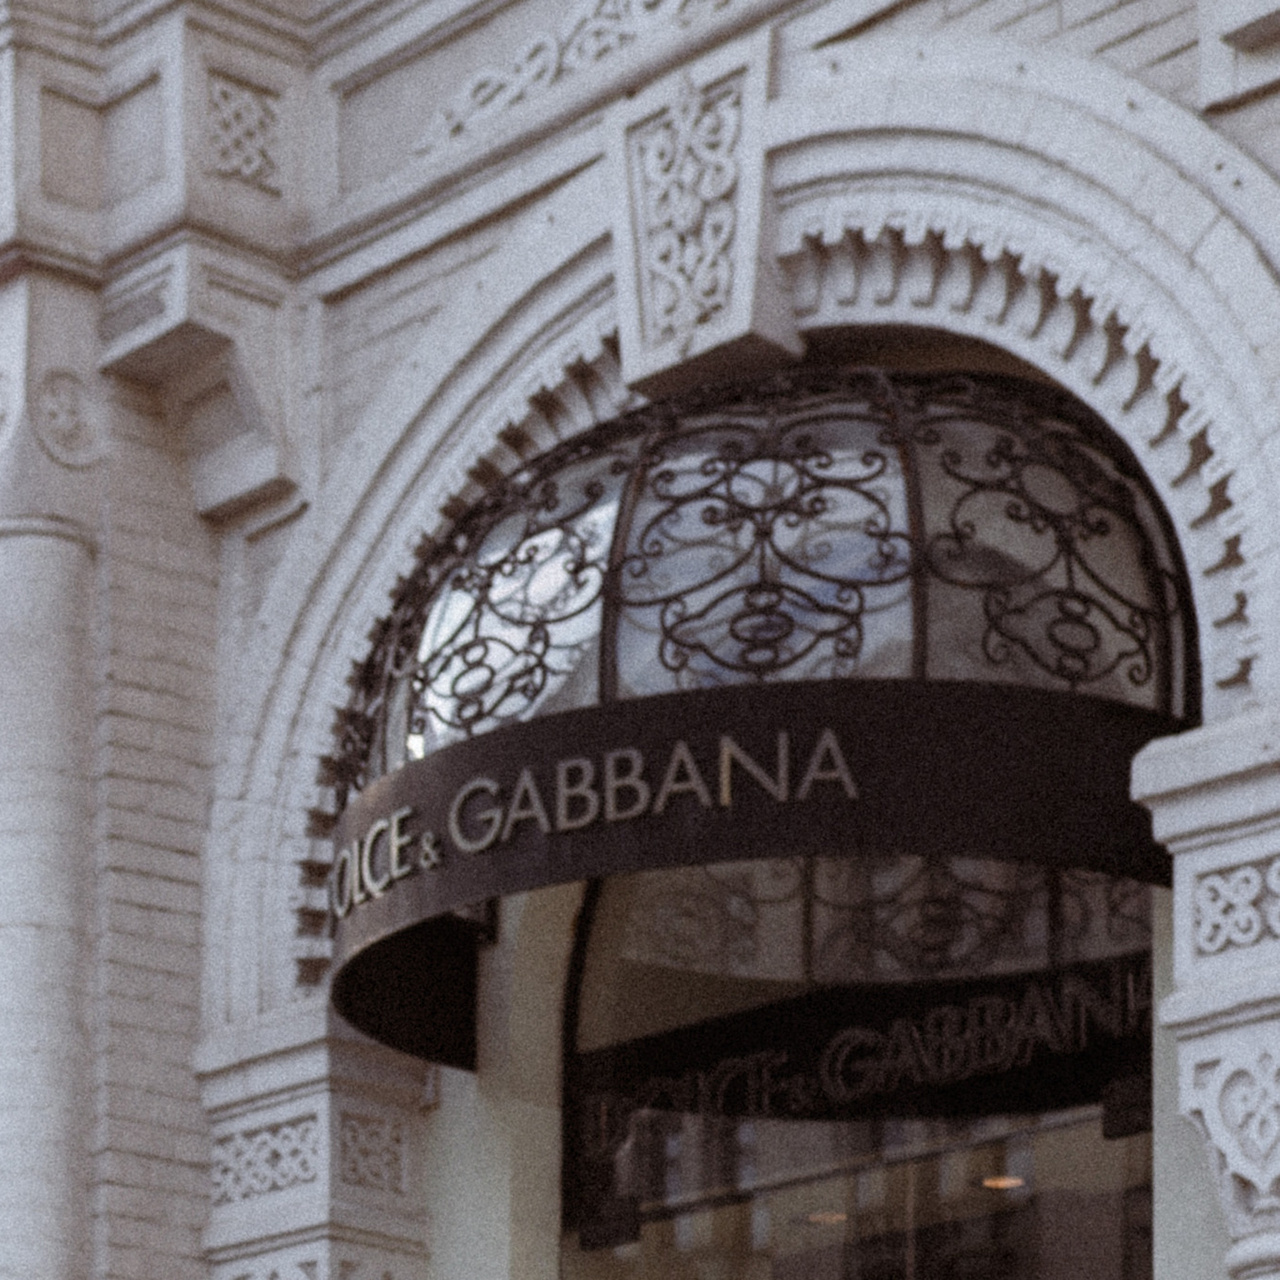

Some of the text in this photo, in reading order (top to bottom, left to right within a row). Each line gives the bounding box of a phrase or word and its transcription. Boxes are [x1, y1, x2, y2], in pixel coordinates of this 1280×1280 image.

[327, 727, 861, 917] OLCE & GABBANA
